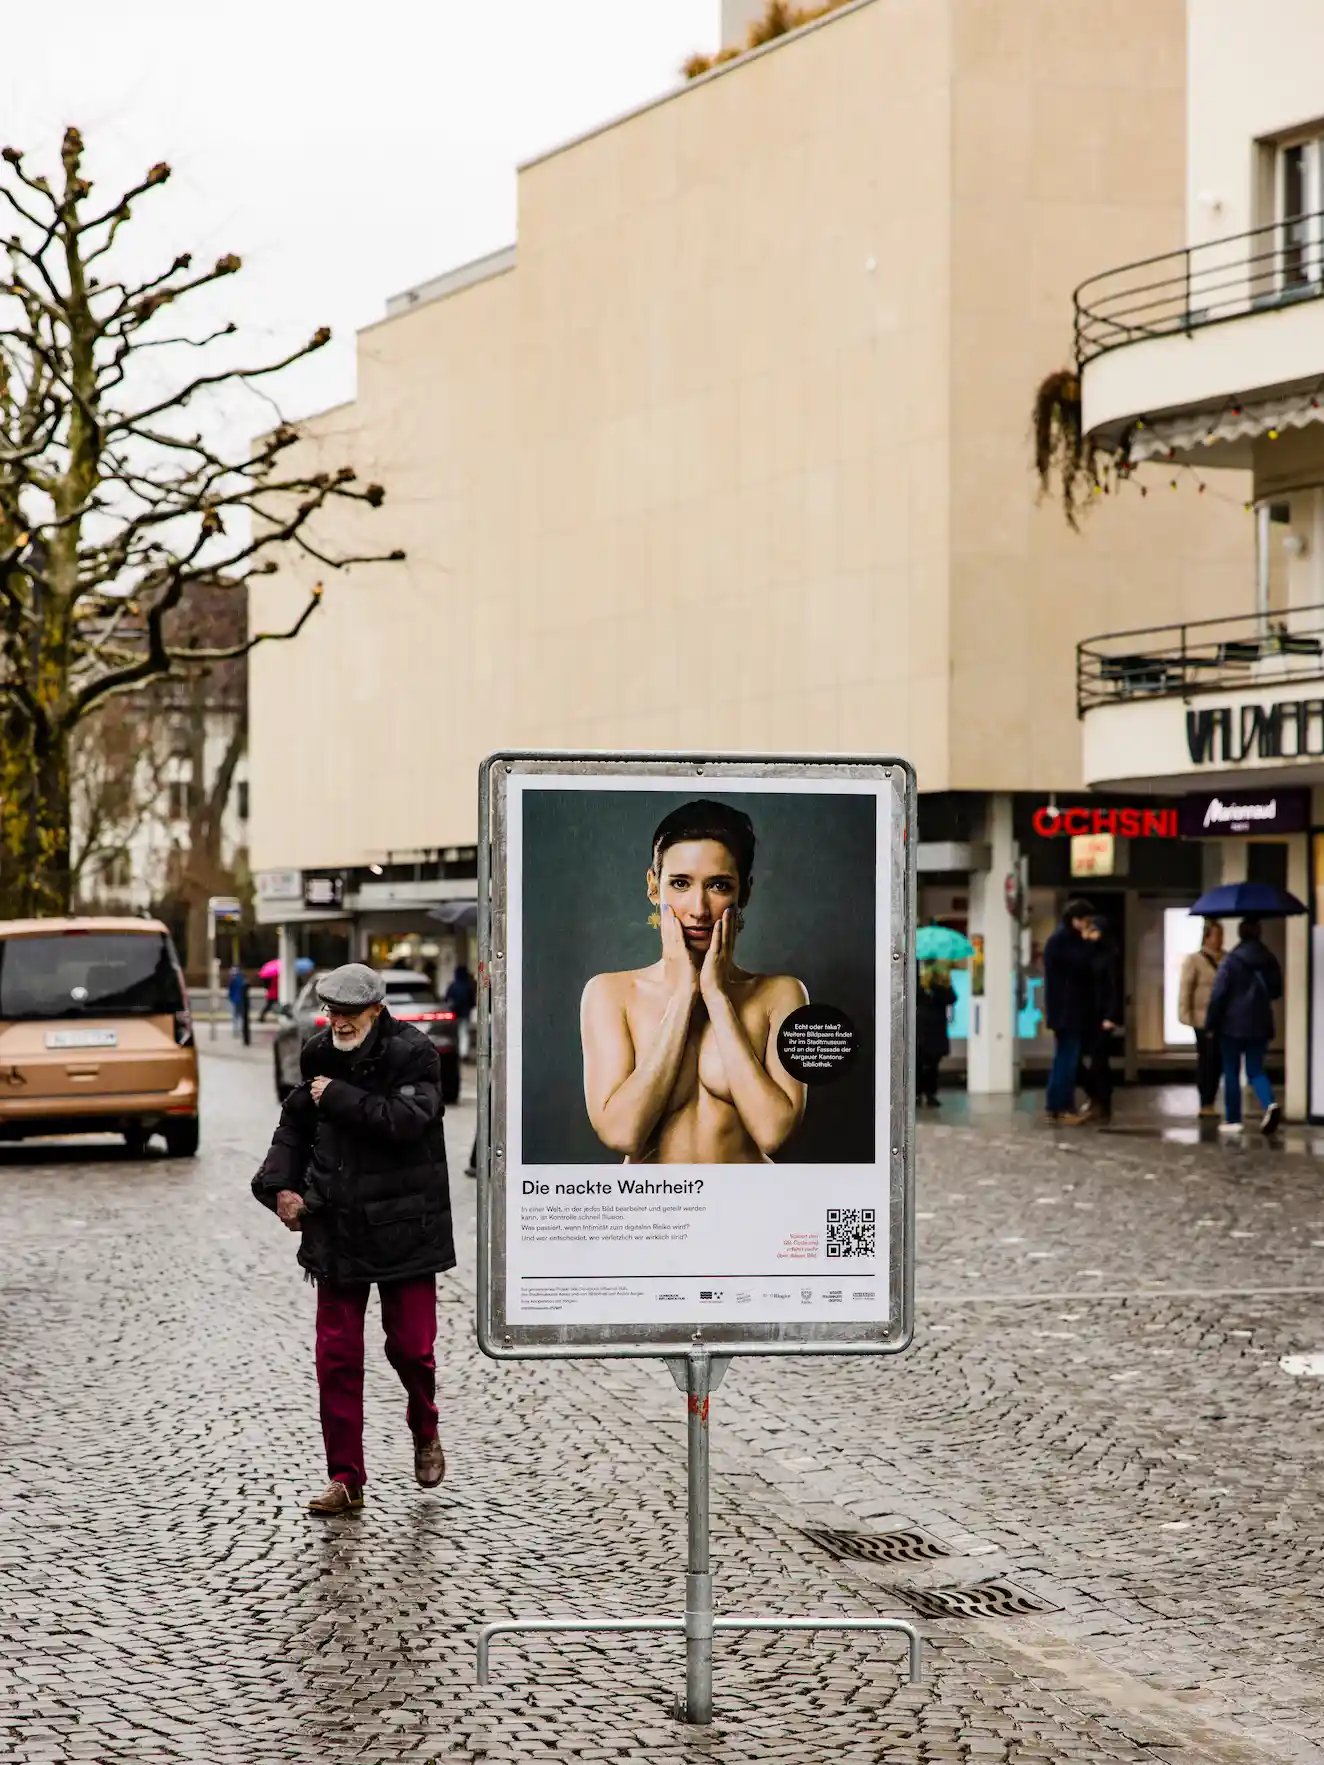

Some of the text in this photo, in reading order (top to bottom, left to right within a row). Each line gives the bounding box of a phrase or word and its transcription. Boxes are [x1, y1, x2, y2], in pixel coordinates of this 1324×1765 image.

[522, 1179, 704, 1195] Die nackte Wahrheit?
